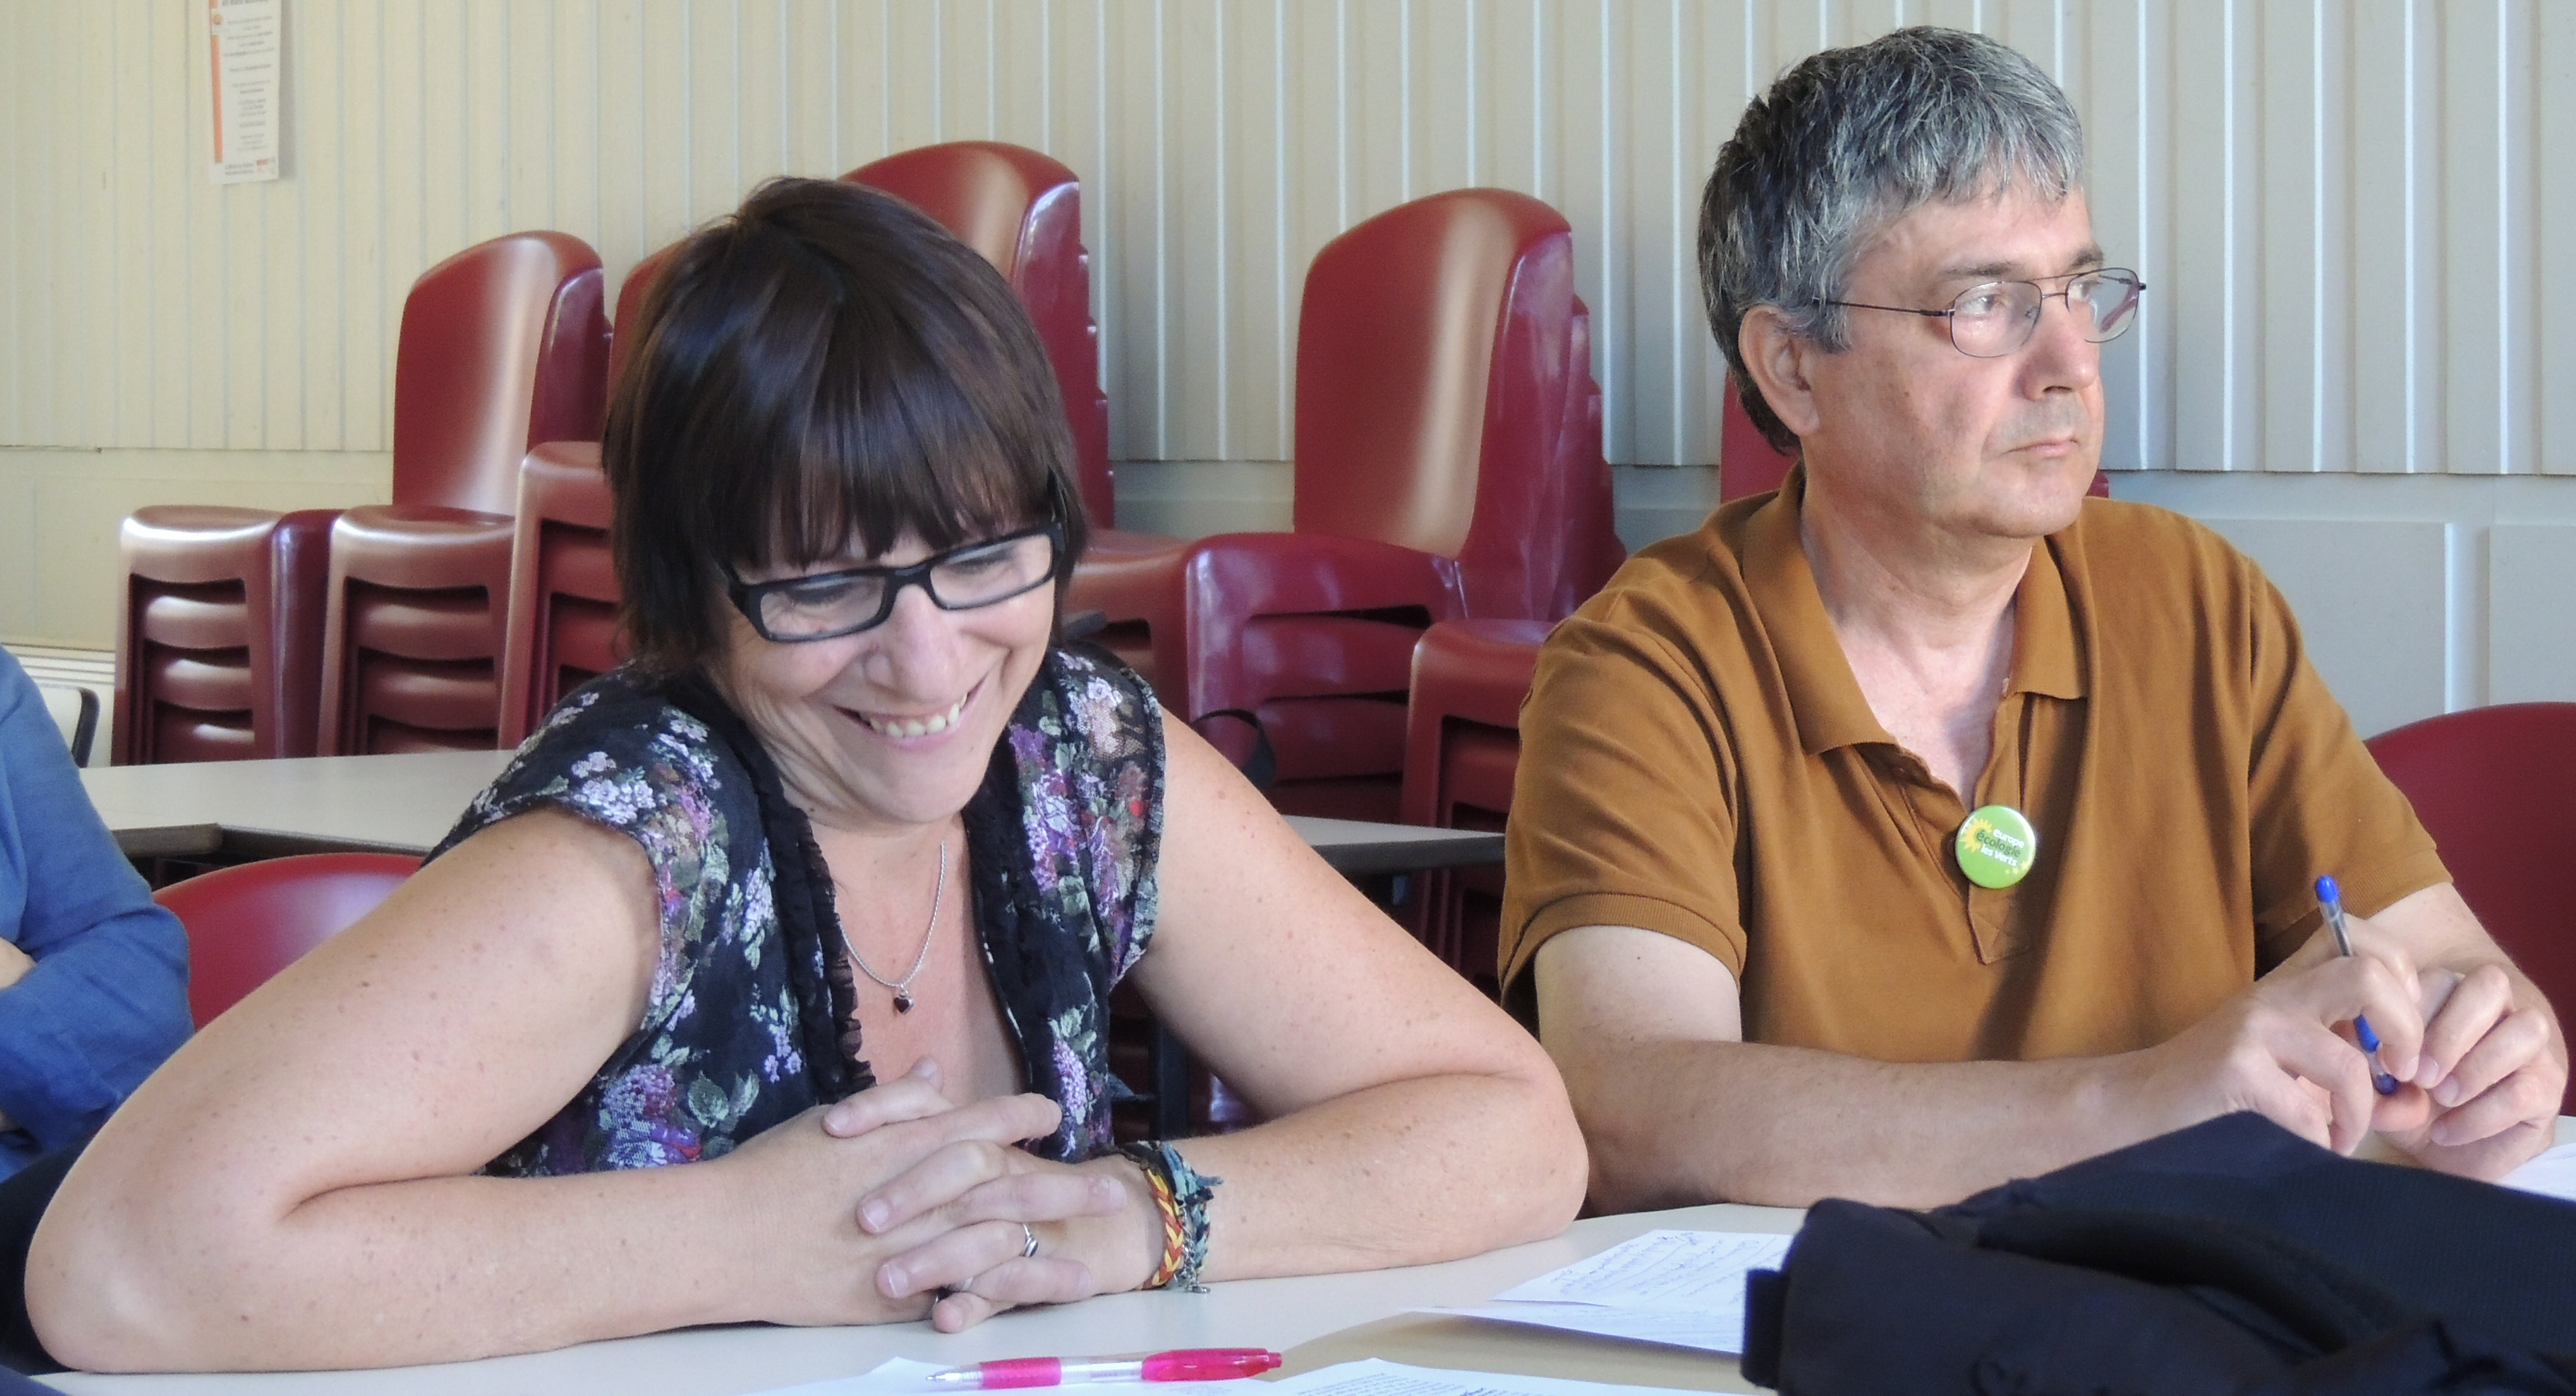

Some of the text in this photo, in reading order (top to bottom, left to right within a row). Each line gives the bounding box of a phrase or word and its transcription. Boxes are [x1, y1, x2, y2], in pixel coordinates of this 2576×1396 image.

[1976, 829, 2021, 858] écologie
[1993, 829, 2025, 849] europe
[1980, 843, 2018, 867] les Verts
